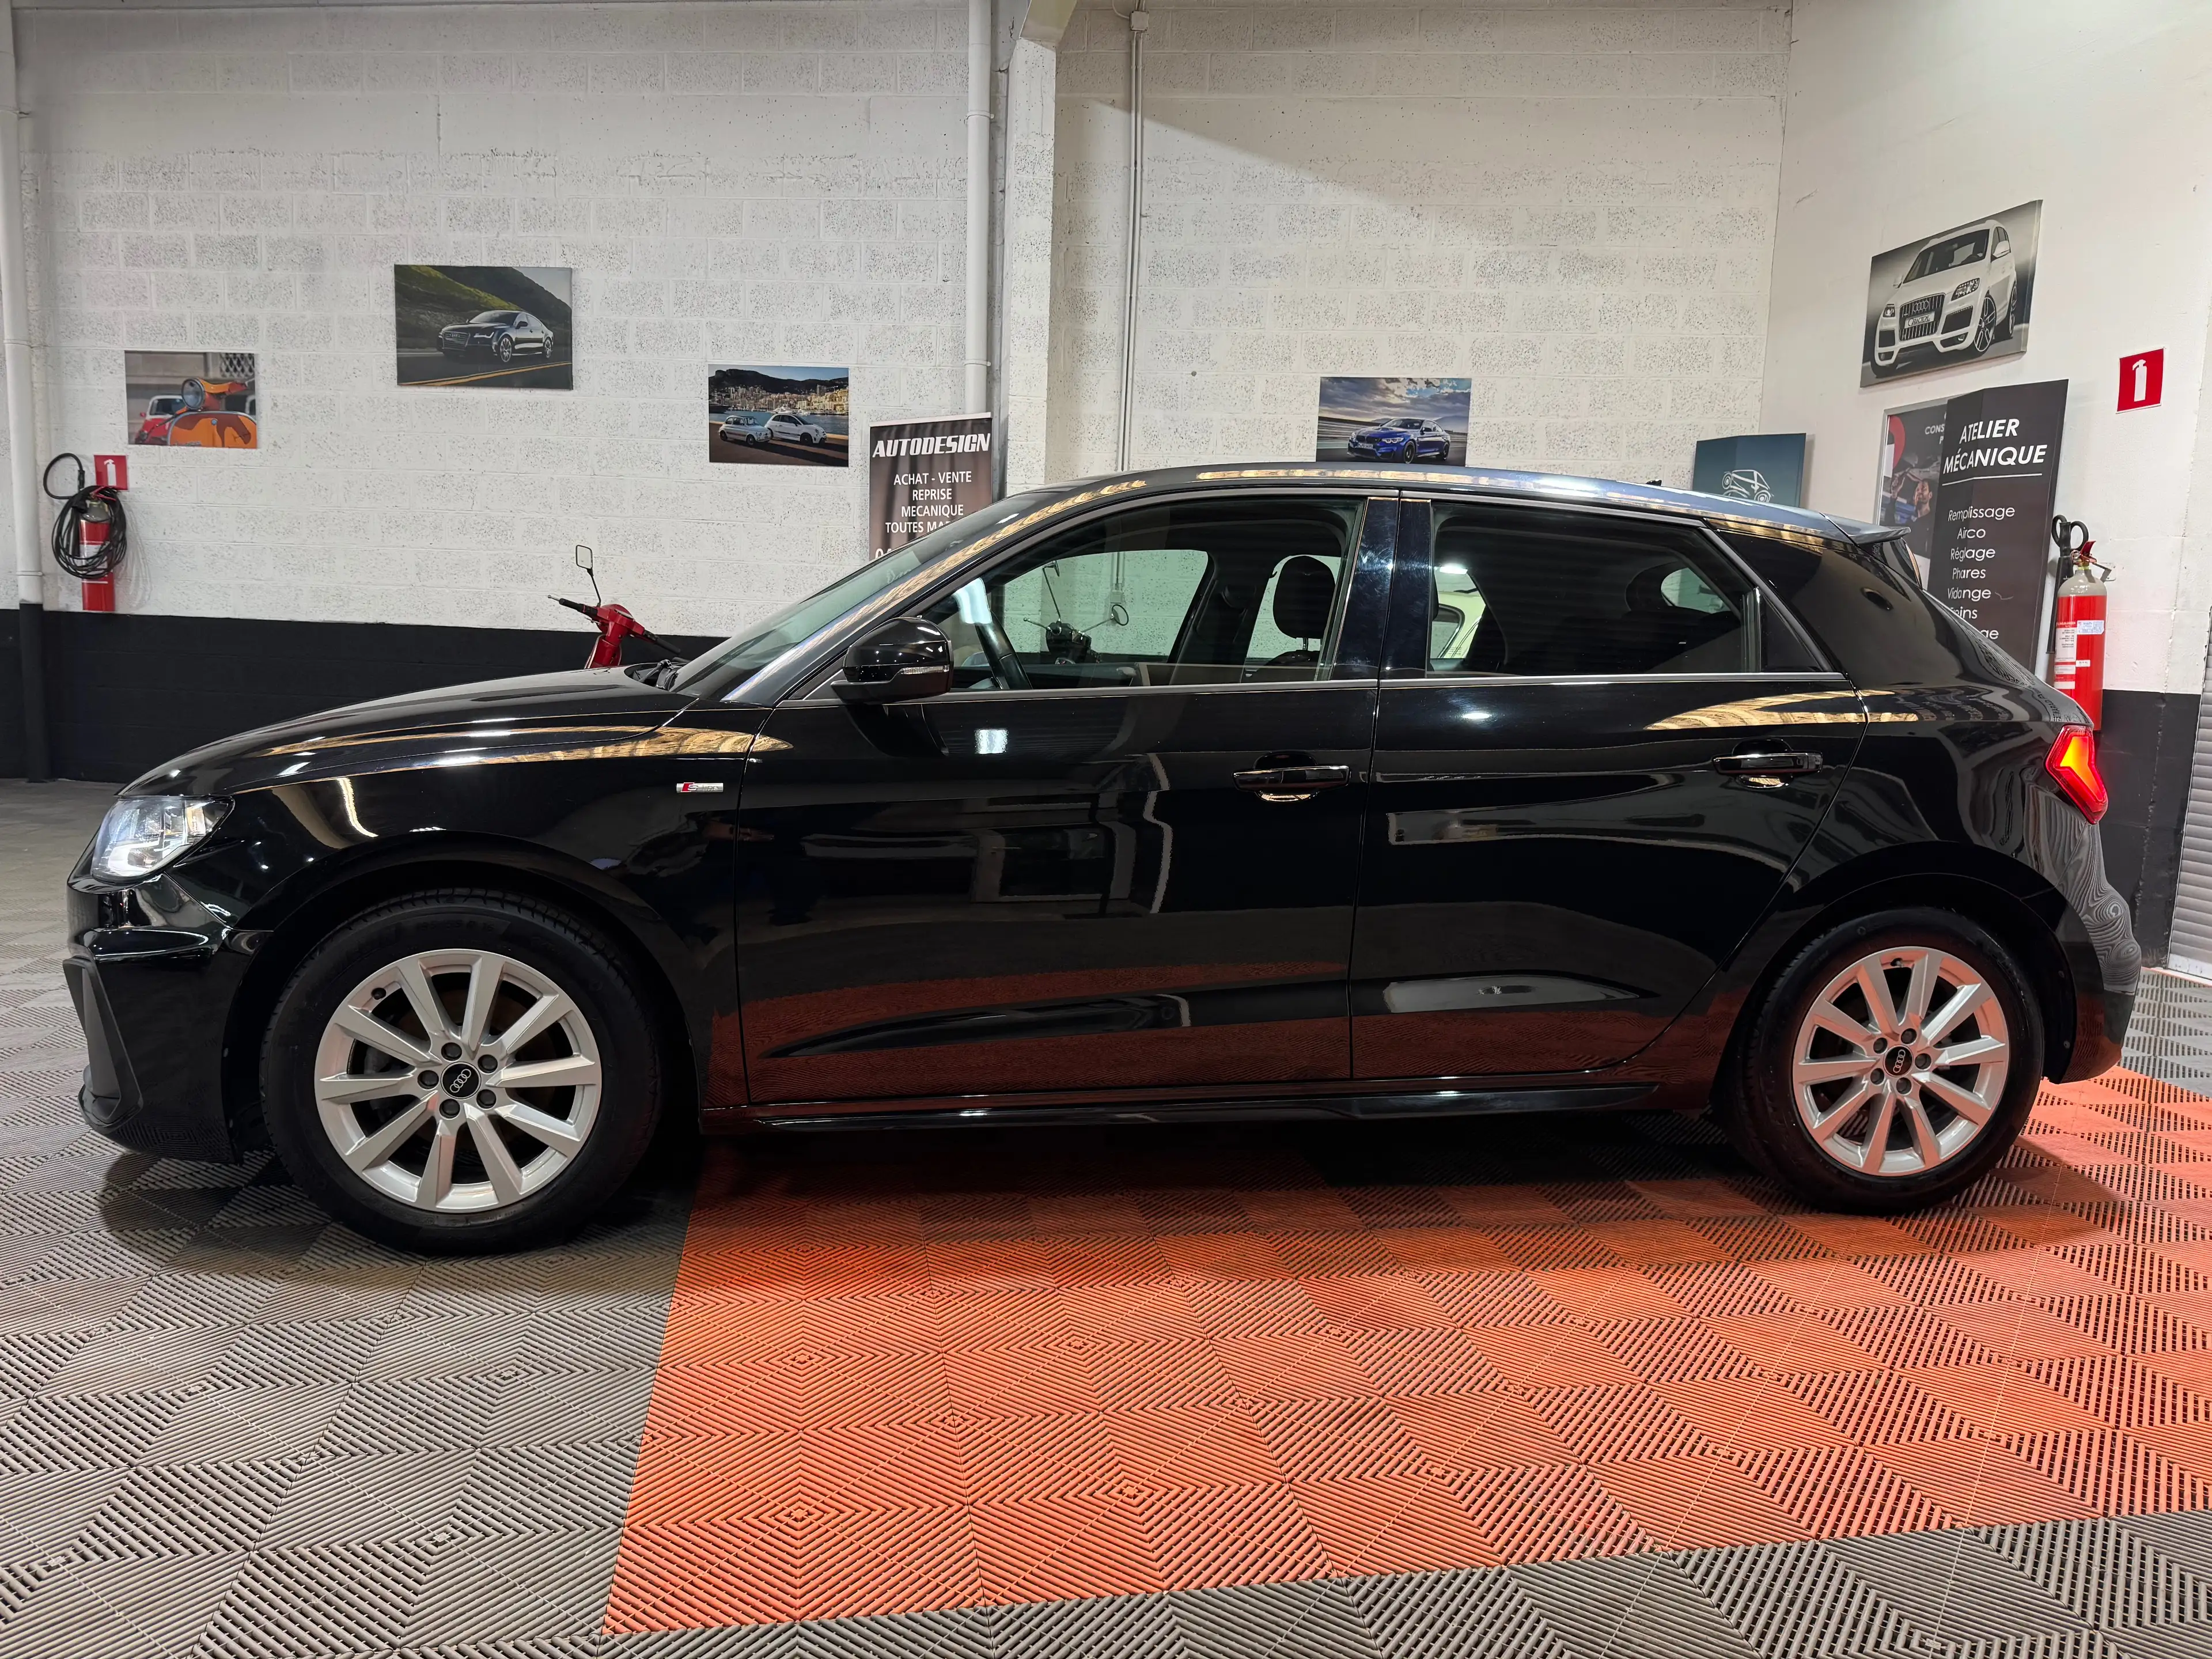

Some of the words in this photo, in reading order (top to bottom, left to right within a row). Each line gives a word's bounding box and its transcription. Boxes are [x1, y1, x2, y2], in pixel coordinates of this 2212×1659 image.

[1959, 418, 2020, 444] ATELIER
[872, 433, 991, 457] AUTODESIGN
[1943, 444, 2047, 474] MÉCANIQUE
[893, 473, 929, 486] ACHAT
[938, 471, 972, 483] VENTE
[912, 488, 952, 501] REPRISE
[901, 505, 964, 517] MECANIQUE
[1948, 506, 2015, 522] Remplissage
[885, 522, 924, 533] TOUTES
[927, 521, 951, 532] MA
[1957, 527, 1986, 540] Airco
[1950, 547, 1995, 562] Réglage
[1952, 567, 1986, 579] Phares
[1948, 587, 1991, 602] Vidange
[1950, 606, 1978, 619] ins
